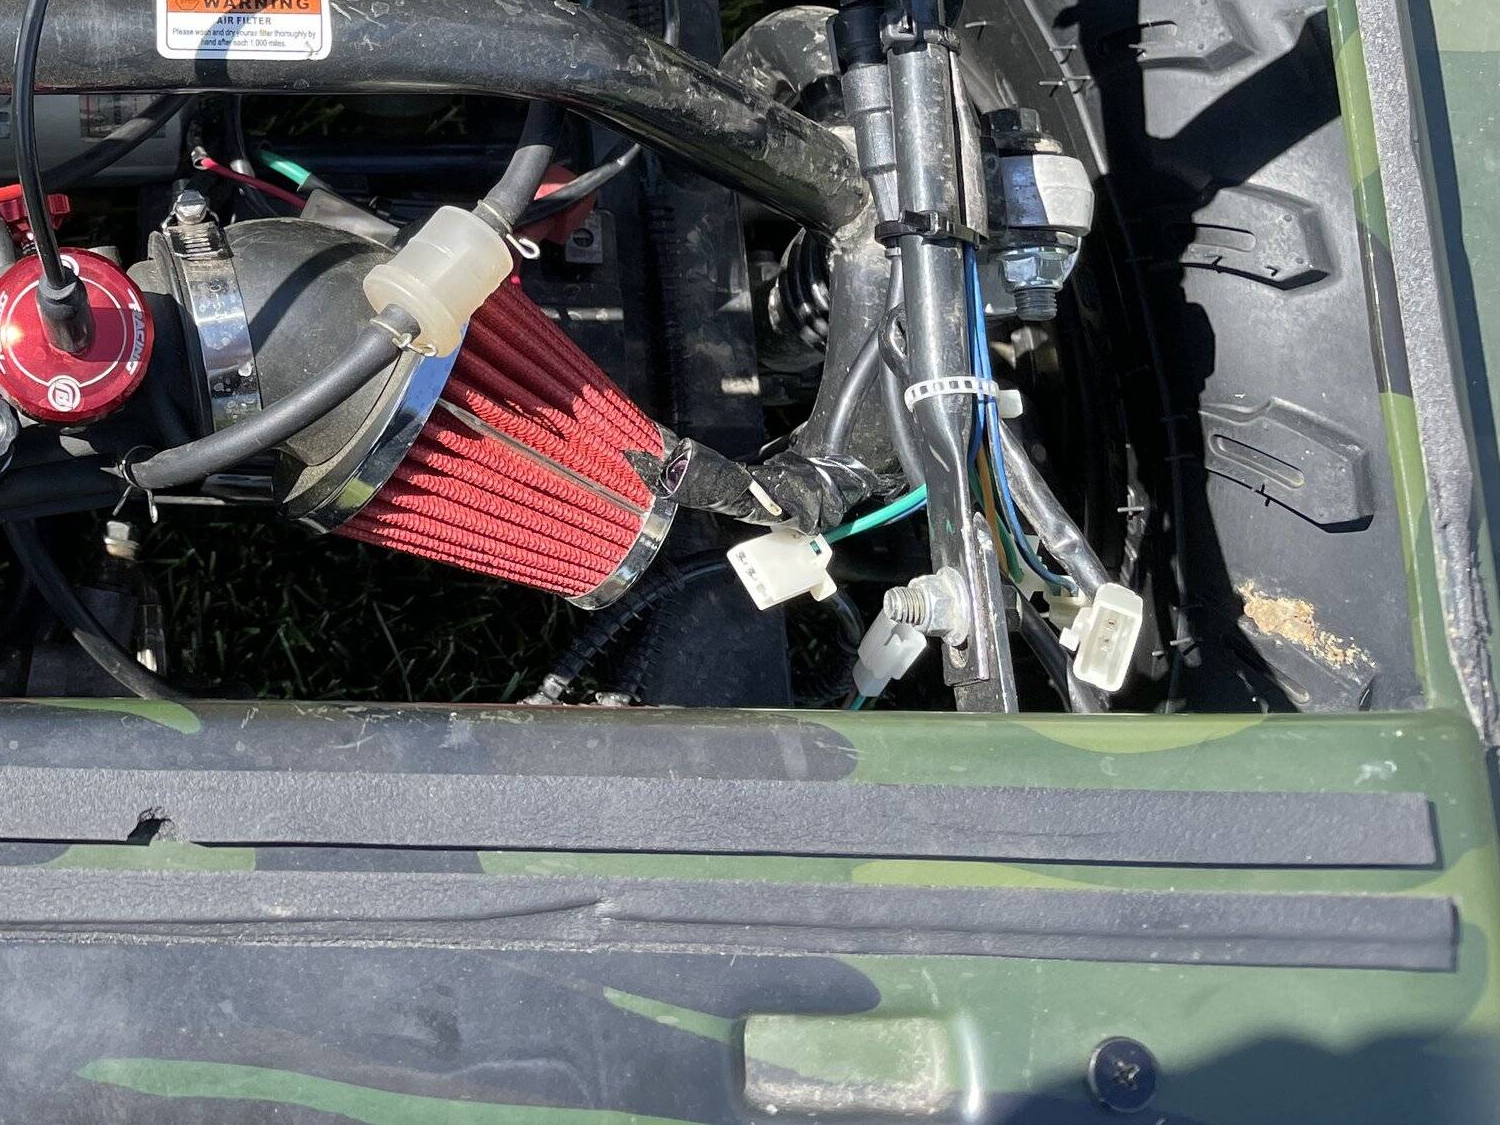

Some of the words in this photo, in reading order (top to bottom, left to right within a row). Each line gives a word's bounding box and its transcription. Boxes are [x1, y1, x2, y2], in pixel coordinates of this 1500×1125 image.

[216, 16, 234, 24] AIR
[236, 16, 272, 25] FILTER
[172, 27, 194, 35] Please
[225, 28, 236, 37] dry
[260, 28, 273, 36] filter
[274, 29, 307, 38] thoroughly
[201, 38, 216, 46] hand
[218, 38, 231, 46] after
[126, 288, 145, 376] RACING
